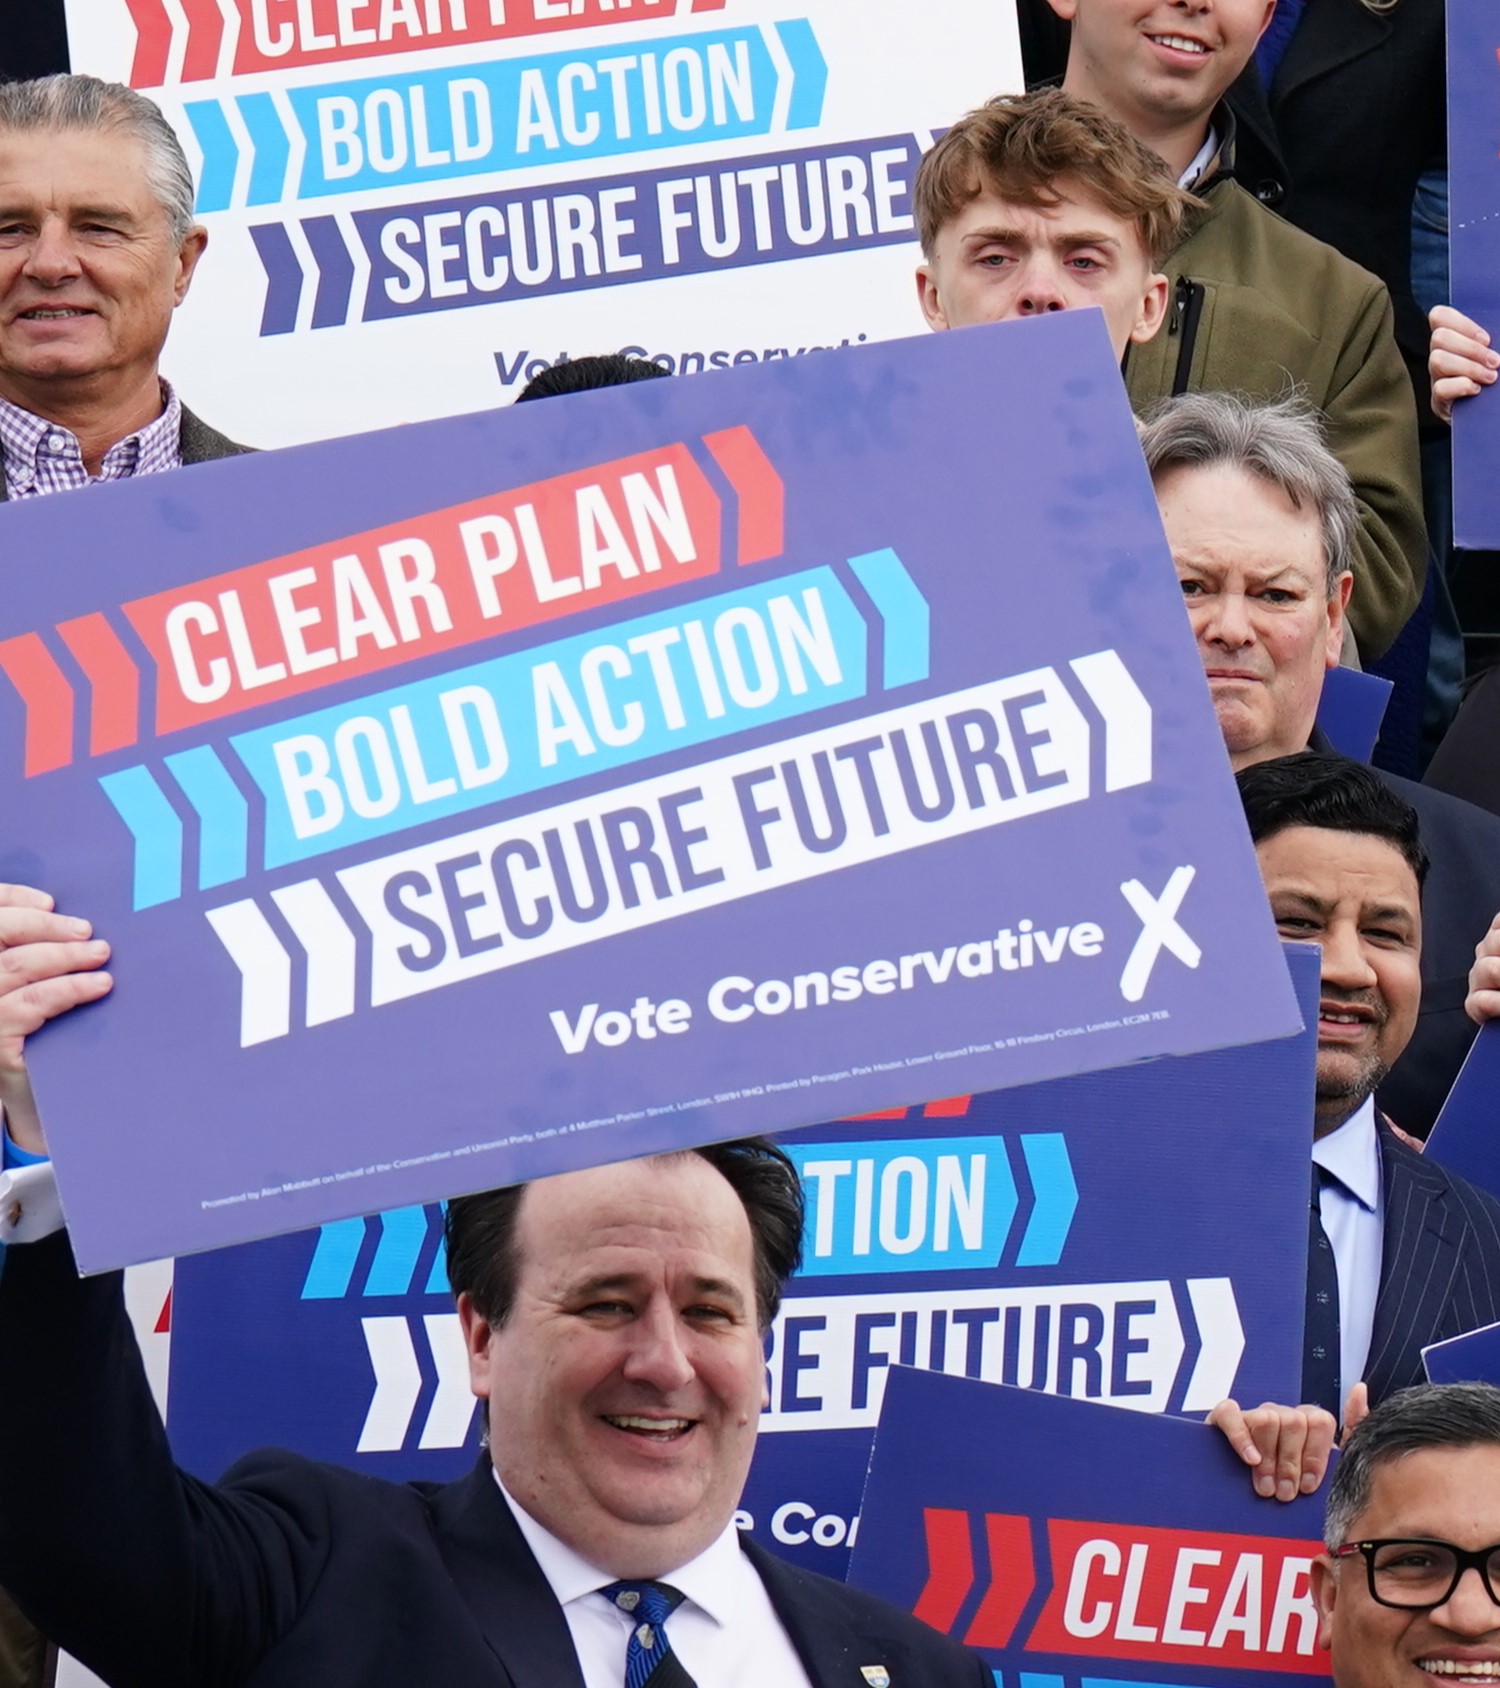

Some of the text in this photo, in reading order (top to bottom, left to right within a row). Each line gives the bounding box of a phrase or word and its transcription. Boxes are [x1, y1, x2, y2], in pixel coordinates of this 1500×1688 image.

[315, 40, 756, 181] BOLD ACTION
[380, 146, 914, 305] SECURE FUTURE
[162, 464, 701, 705] CLEAR PLAN
[271, 586, 845, 840] BOLD ACTION
[381, 687, 1069, 974] SECURE FUTURE
[548, 916, 1104, 1055] Vote Conservative
[803, 1153, 987, 1257] TION
[1063, 1539, 1321, 1656] CLEAR
